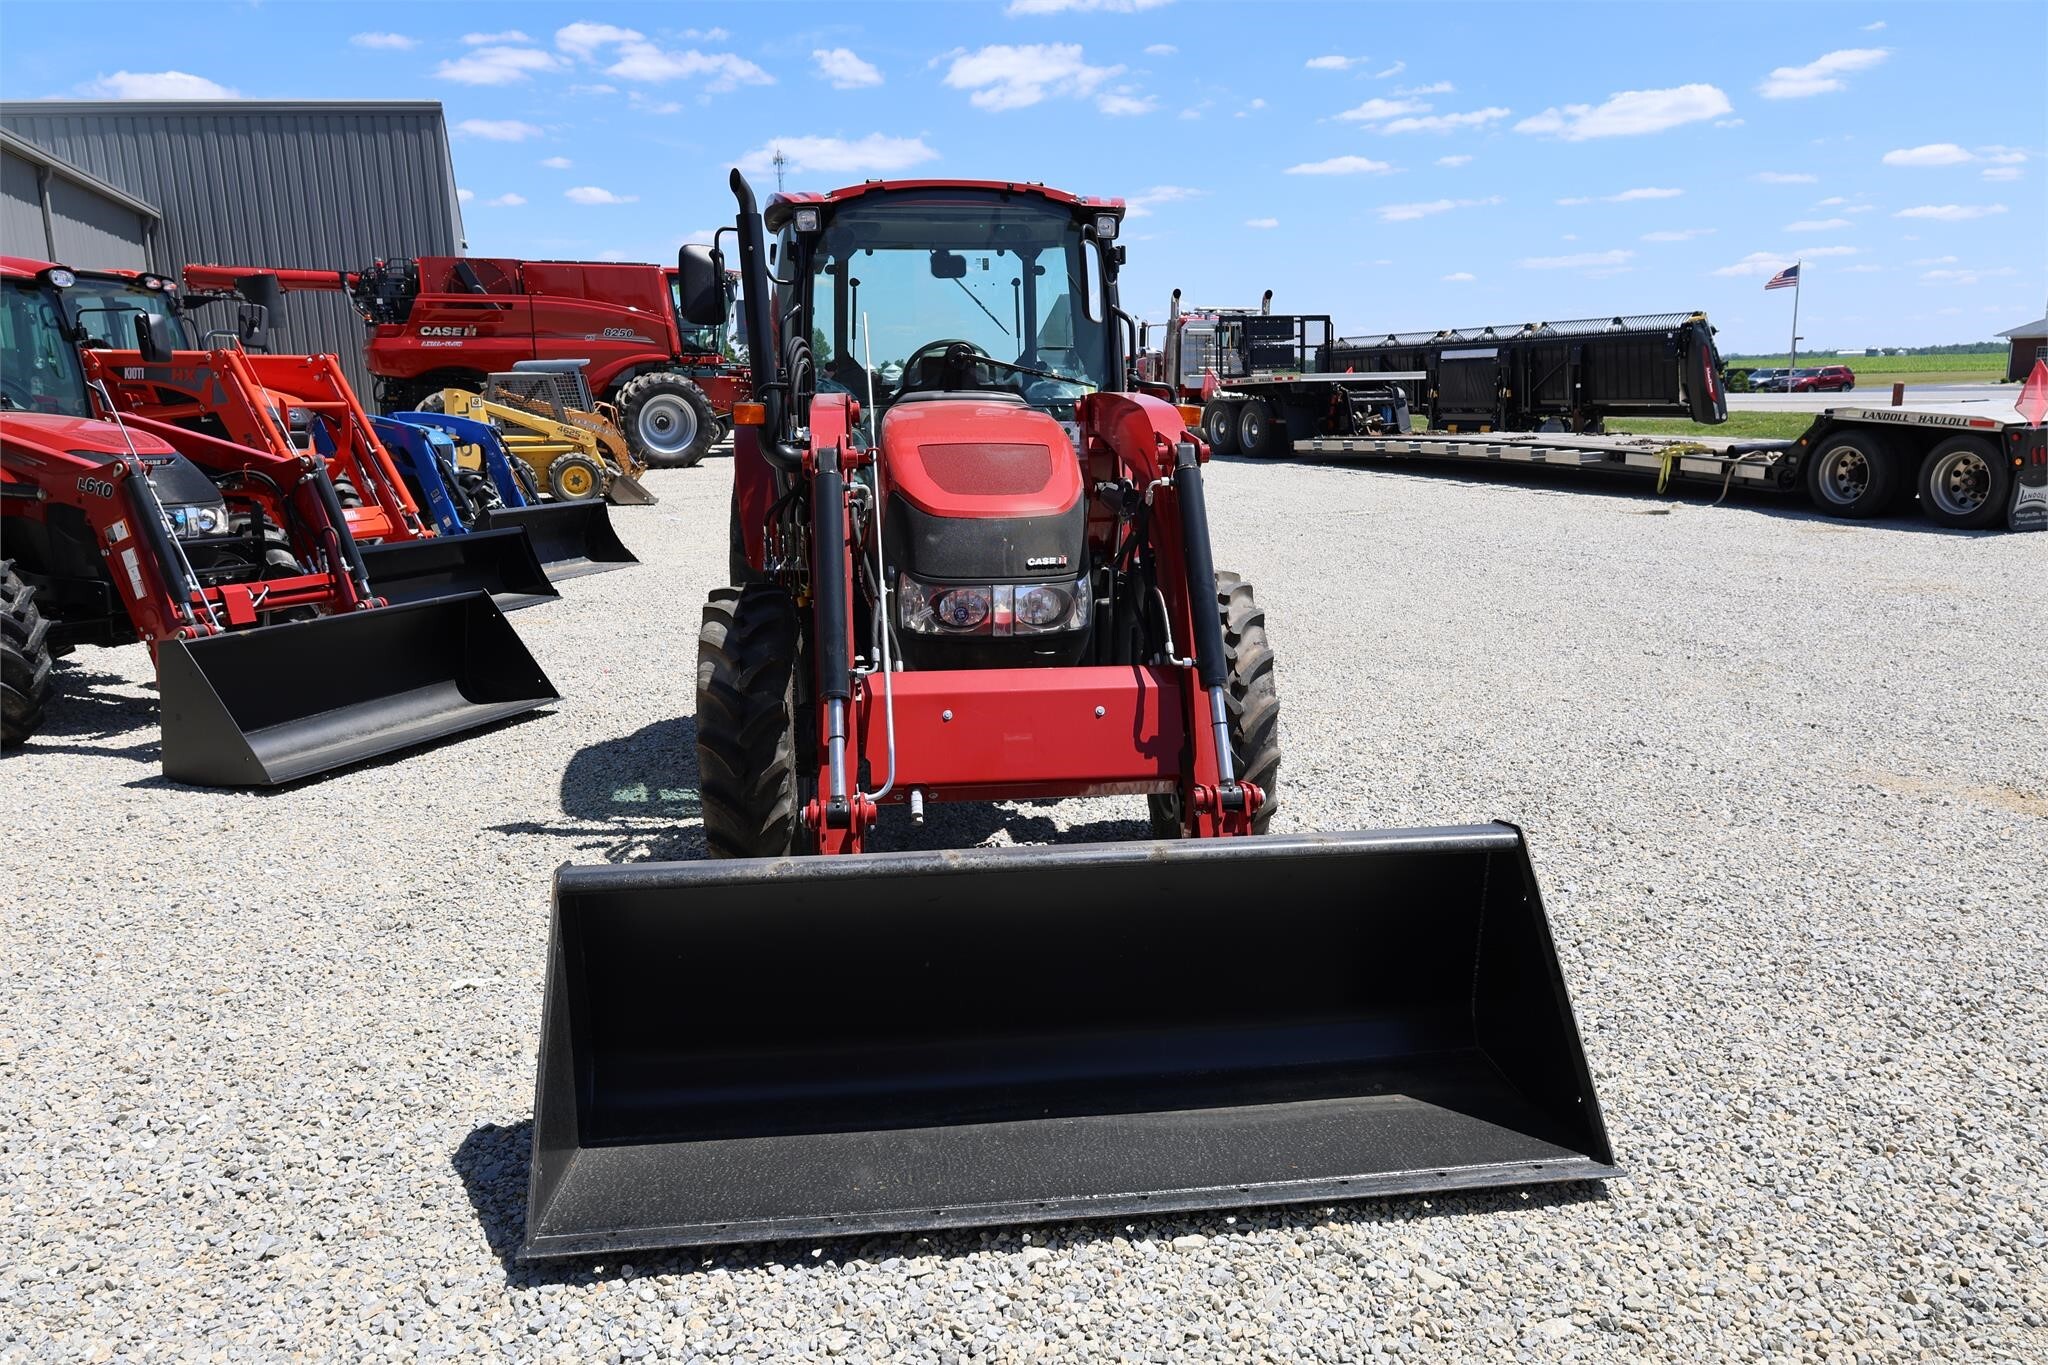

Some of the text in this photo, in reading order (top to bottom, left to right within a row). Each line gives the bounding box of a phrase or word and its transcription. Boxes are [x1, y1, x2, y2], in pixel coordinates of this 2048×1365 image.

[420, 326, 462, 336] CASE
[604, 328, 634, 338] 8250
[1862, 411, 1968, 427] LANDOLL HAULOLL
[556, 425, 581, 438] 4625
[77, 477, 114, 499] L610
[1027, 557, 1057, 566] CASE
